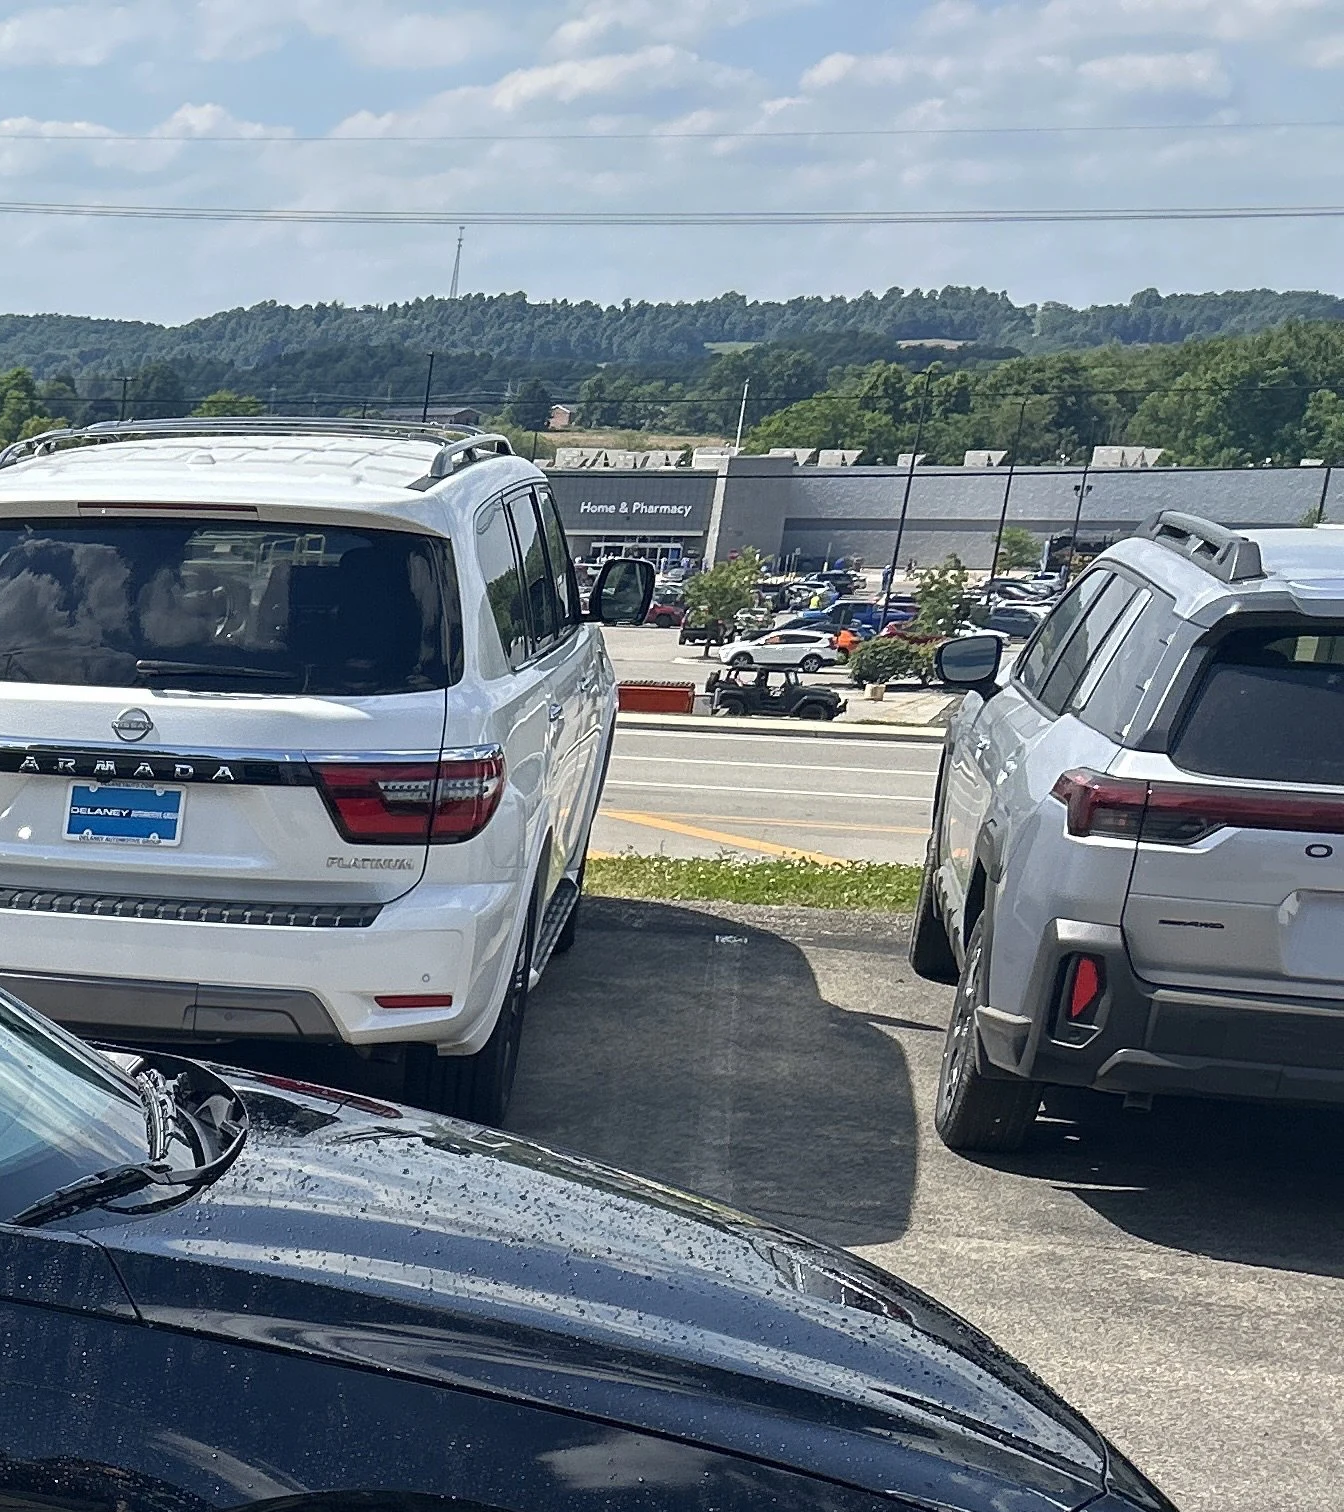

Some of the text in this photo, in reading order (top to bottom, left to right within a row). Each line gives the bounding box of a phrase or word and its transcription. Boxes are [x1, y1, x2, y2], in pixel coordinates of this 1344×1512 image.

[580, 501, 692, 518] Home & Pharmacy
[112, 720, 154, 730] NISSAN
[19, 755, 235, 781] ARMADA
[71, 806, 130, 817] DELANEY
[326, 856, 414, 870] PLATINUM
